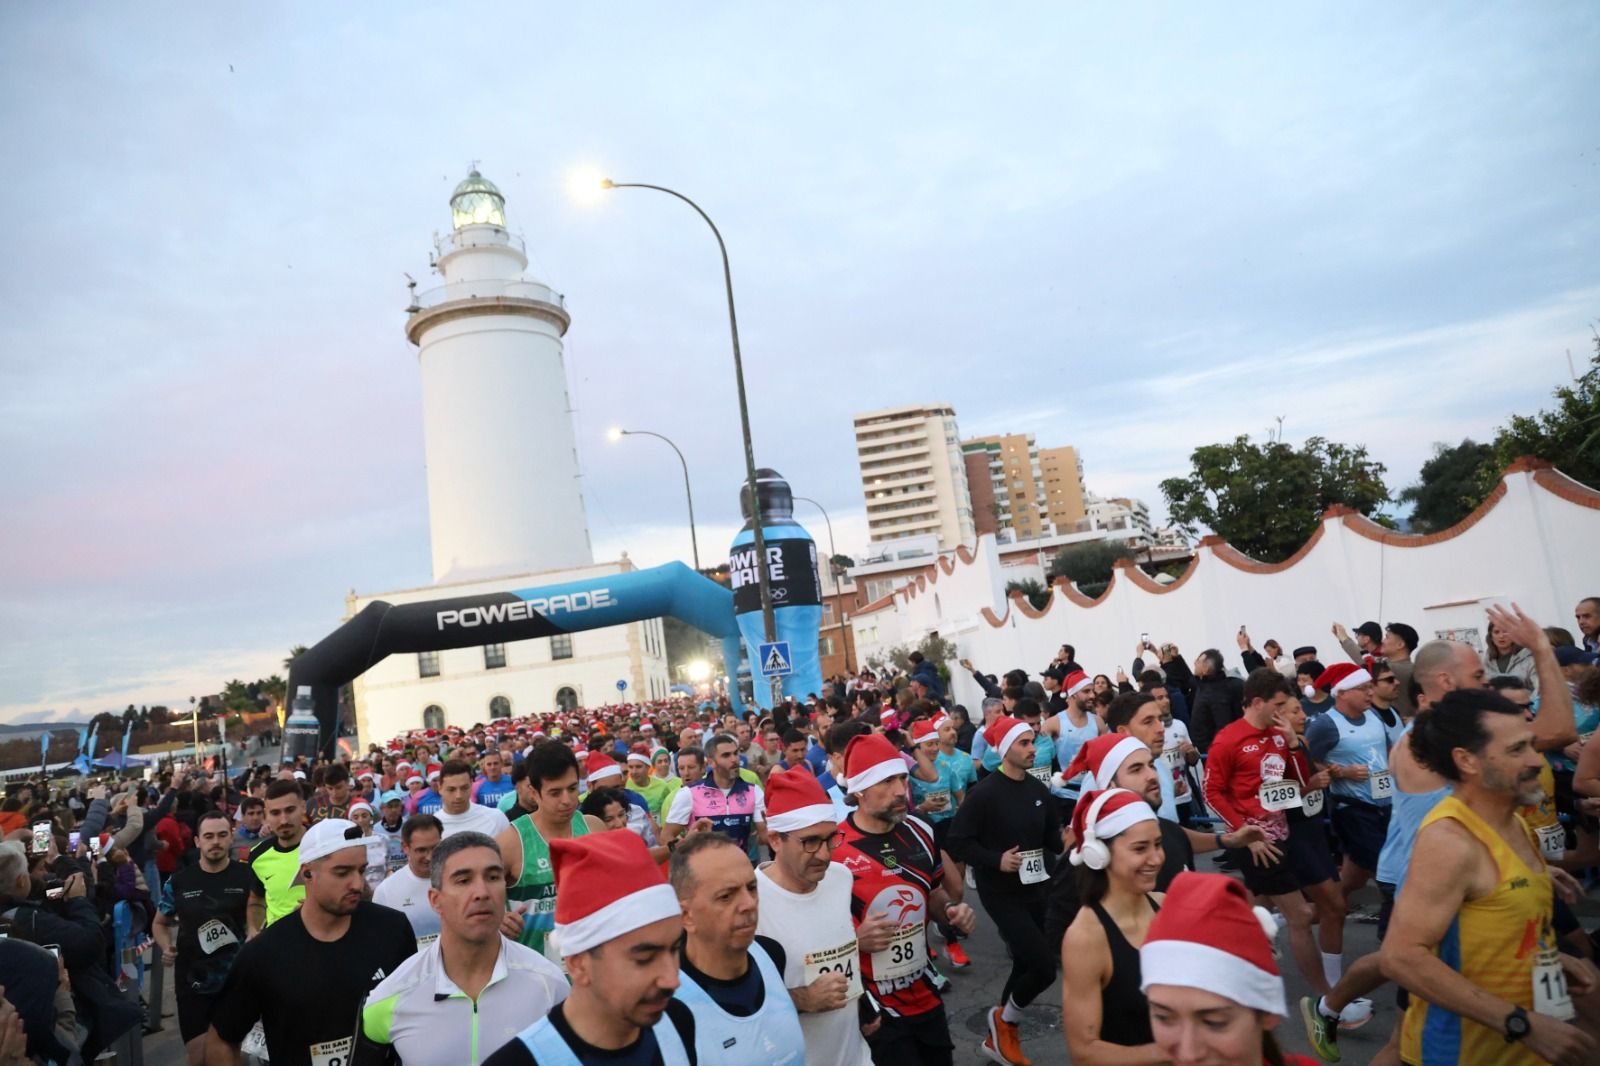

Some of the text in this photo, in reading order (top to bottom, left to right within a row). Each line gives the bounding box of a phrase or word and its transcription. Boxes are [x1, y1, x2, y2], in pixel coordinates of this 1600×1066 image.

[437, 588, 610, 630] POWERADE
[1378, 777, 1391, 790] 53
[1264, 787, 1296, 803] 1289
[205, 926, 228, 943] 484
[891, 941, 914, 964] 38
[320, 1040, 348, 1051] VII SAN
